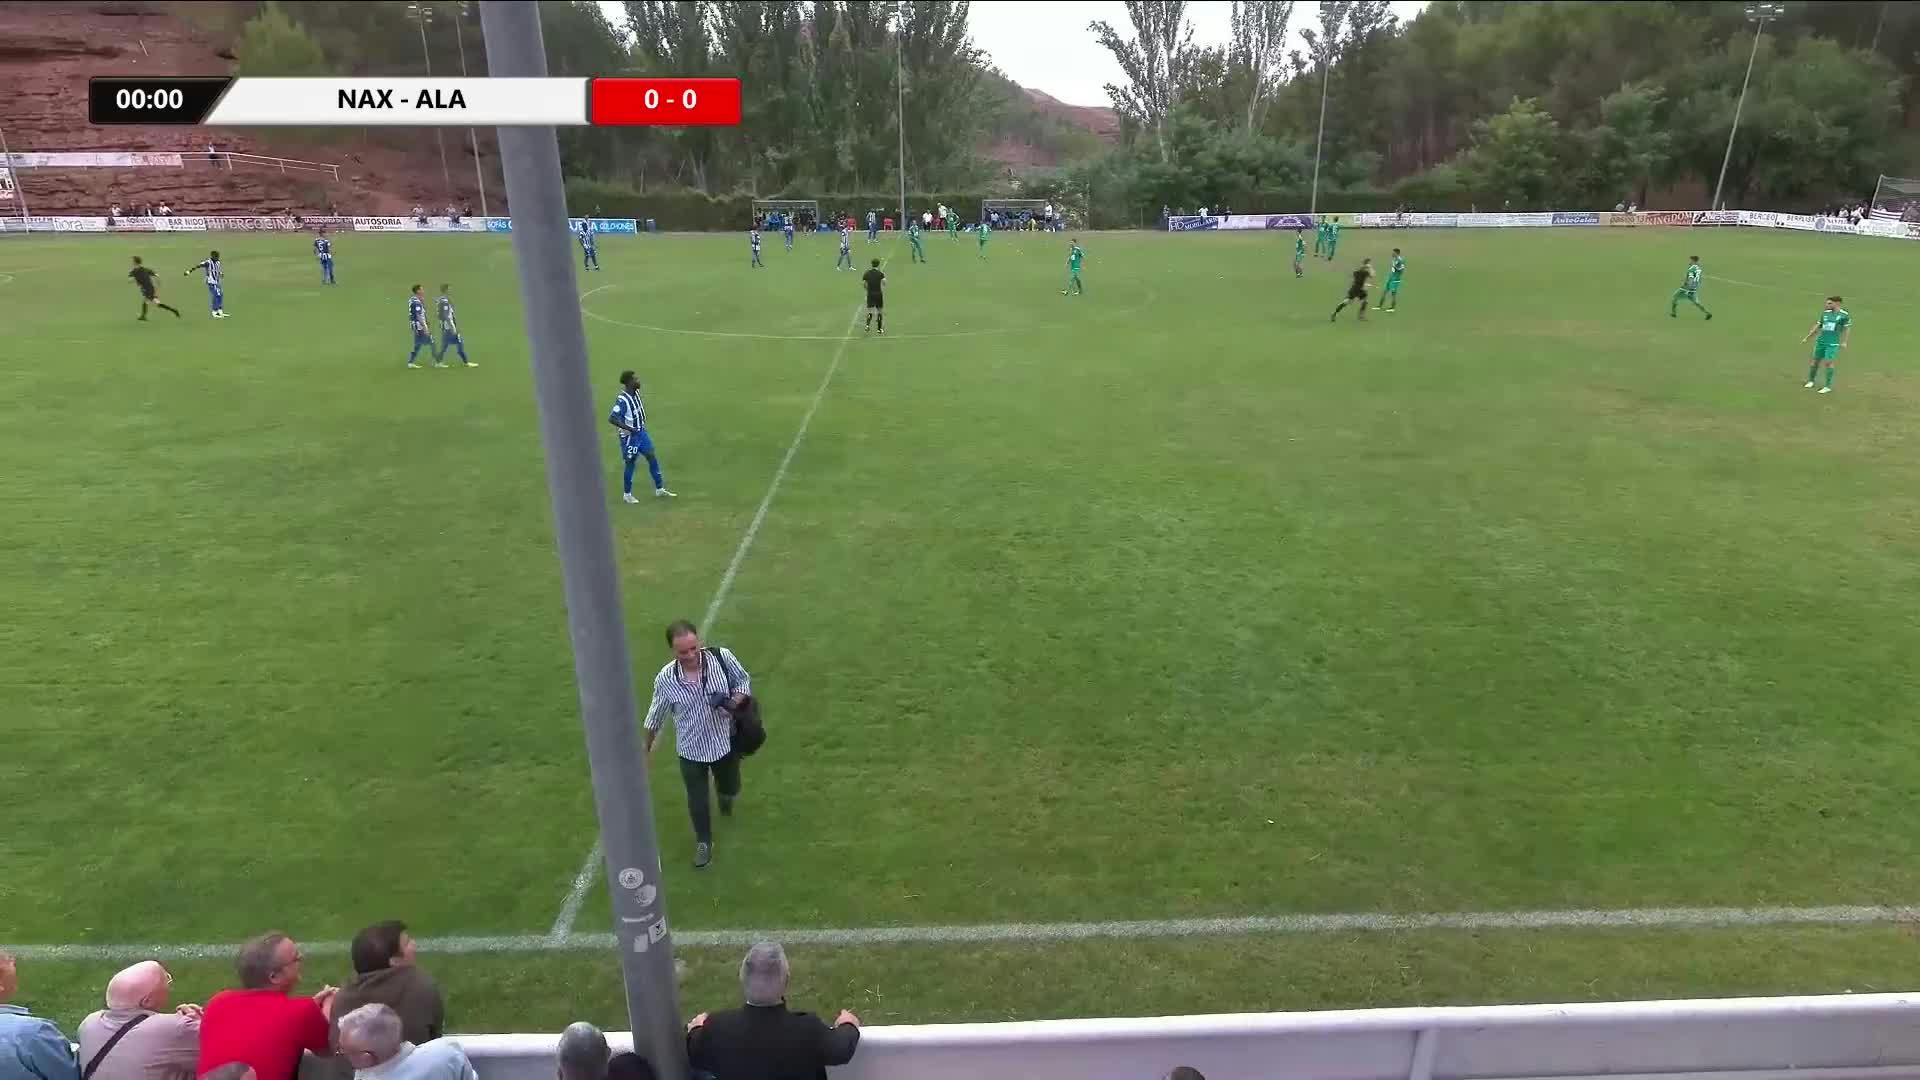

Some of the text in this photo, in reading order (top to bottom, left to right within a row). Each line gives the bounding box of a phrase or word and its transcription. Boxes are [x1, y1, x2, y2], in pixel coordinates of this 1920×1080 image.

[168, 218, 183, 226] BAR
[354, 217, 402, 226] AUTOSORIA
[627, 445, 638, 454] 20
